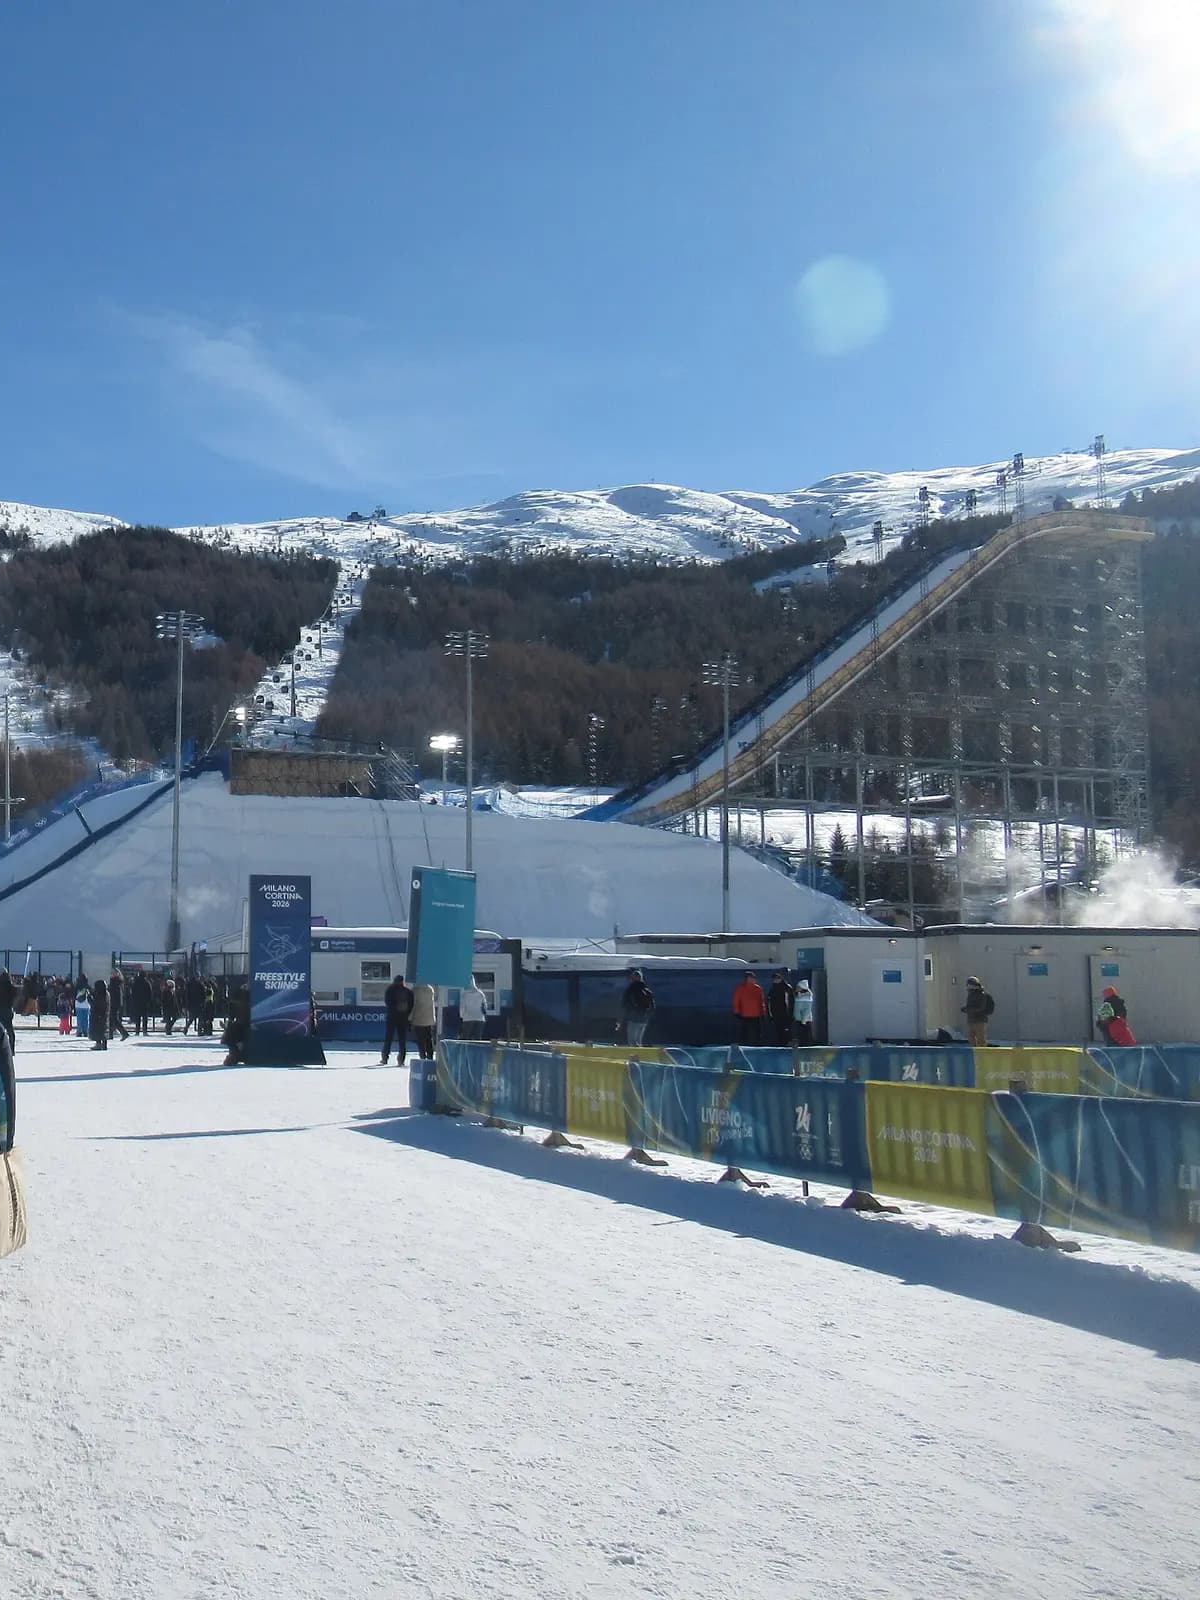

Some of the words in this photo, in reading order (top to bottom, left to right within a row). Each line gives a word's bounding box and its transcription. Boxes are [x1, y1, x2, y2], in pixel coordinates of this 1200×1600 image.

[265, 892, 303, 900] CORTINA
[271, 900, 290, 908] 2026
[254, 972, 306, 981] FREESTYLE
[264, 981, 299, 990] SKIING
[318, 1012, 363, 1021] MILANO
